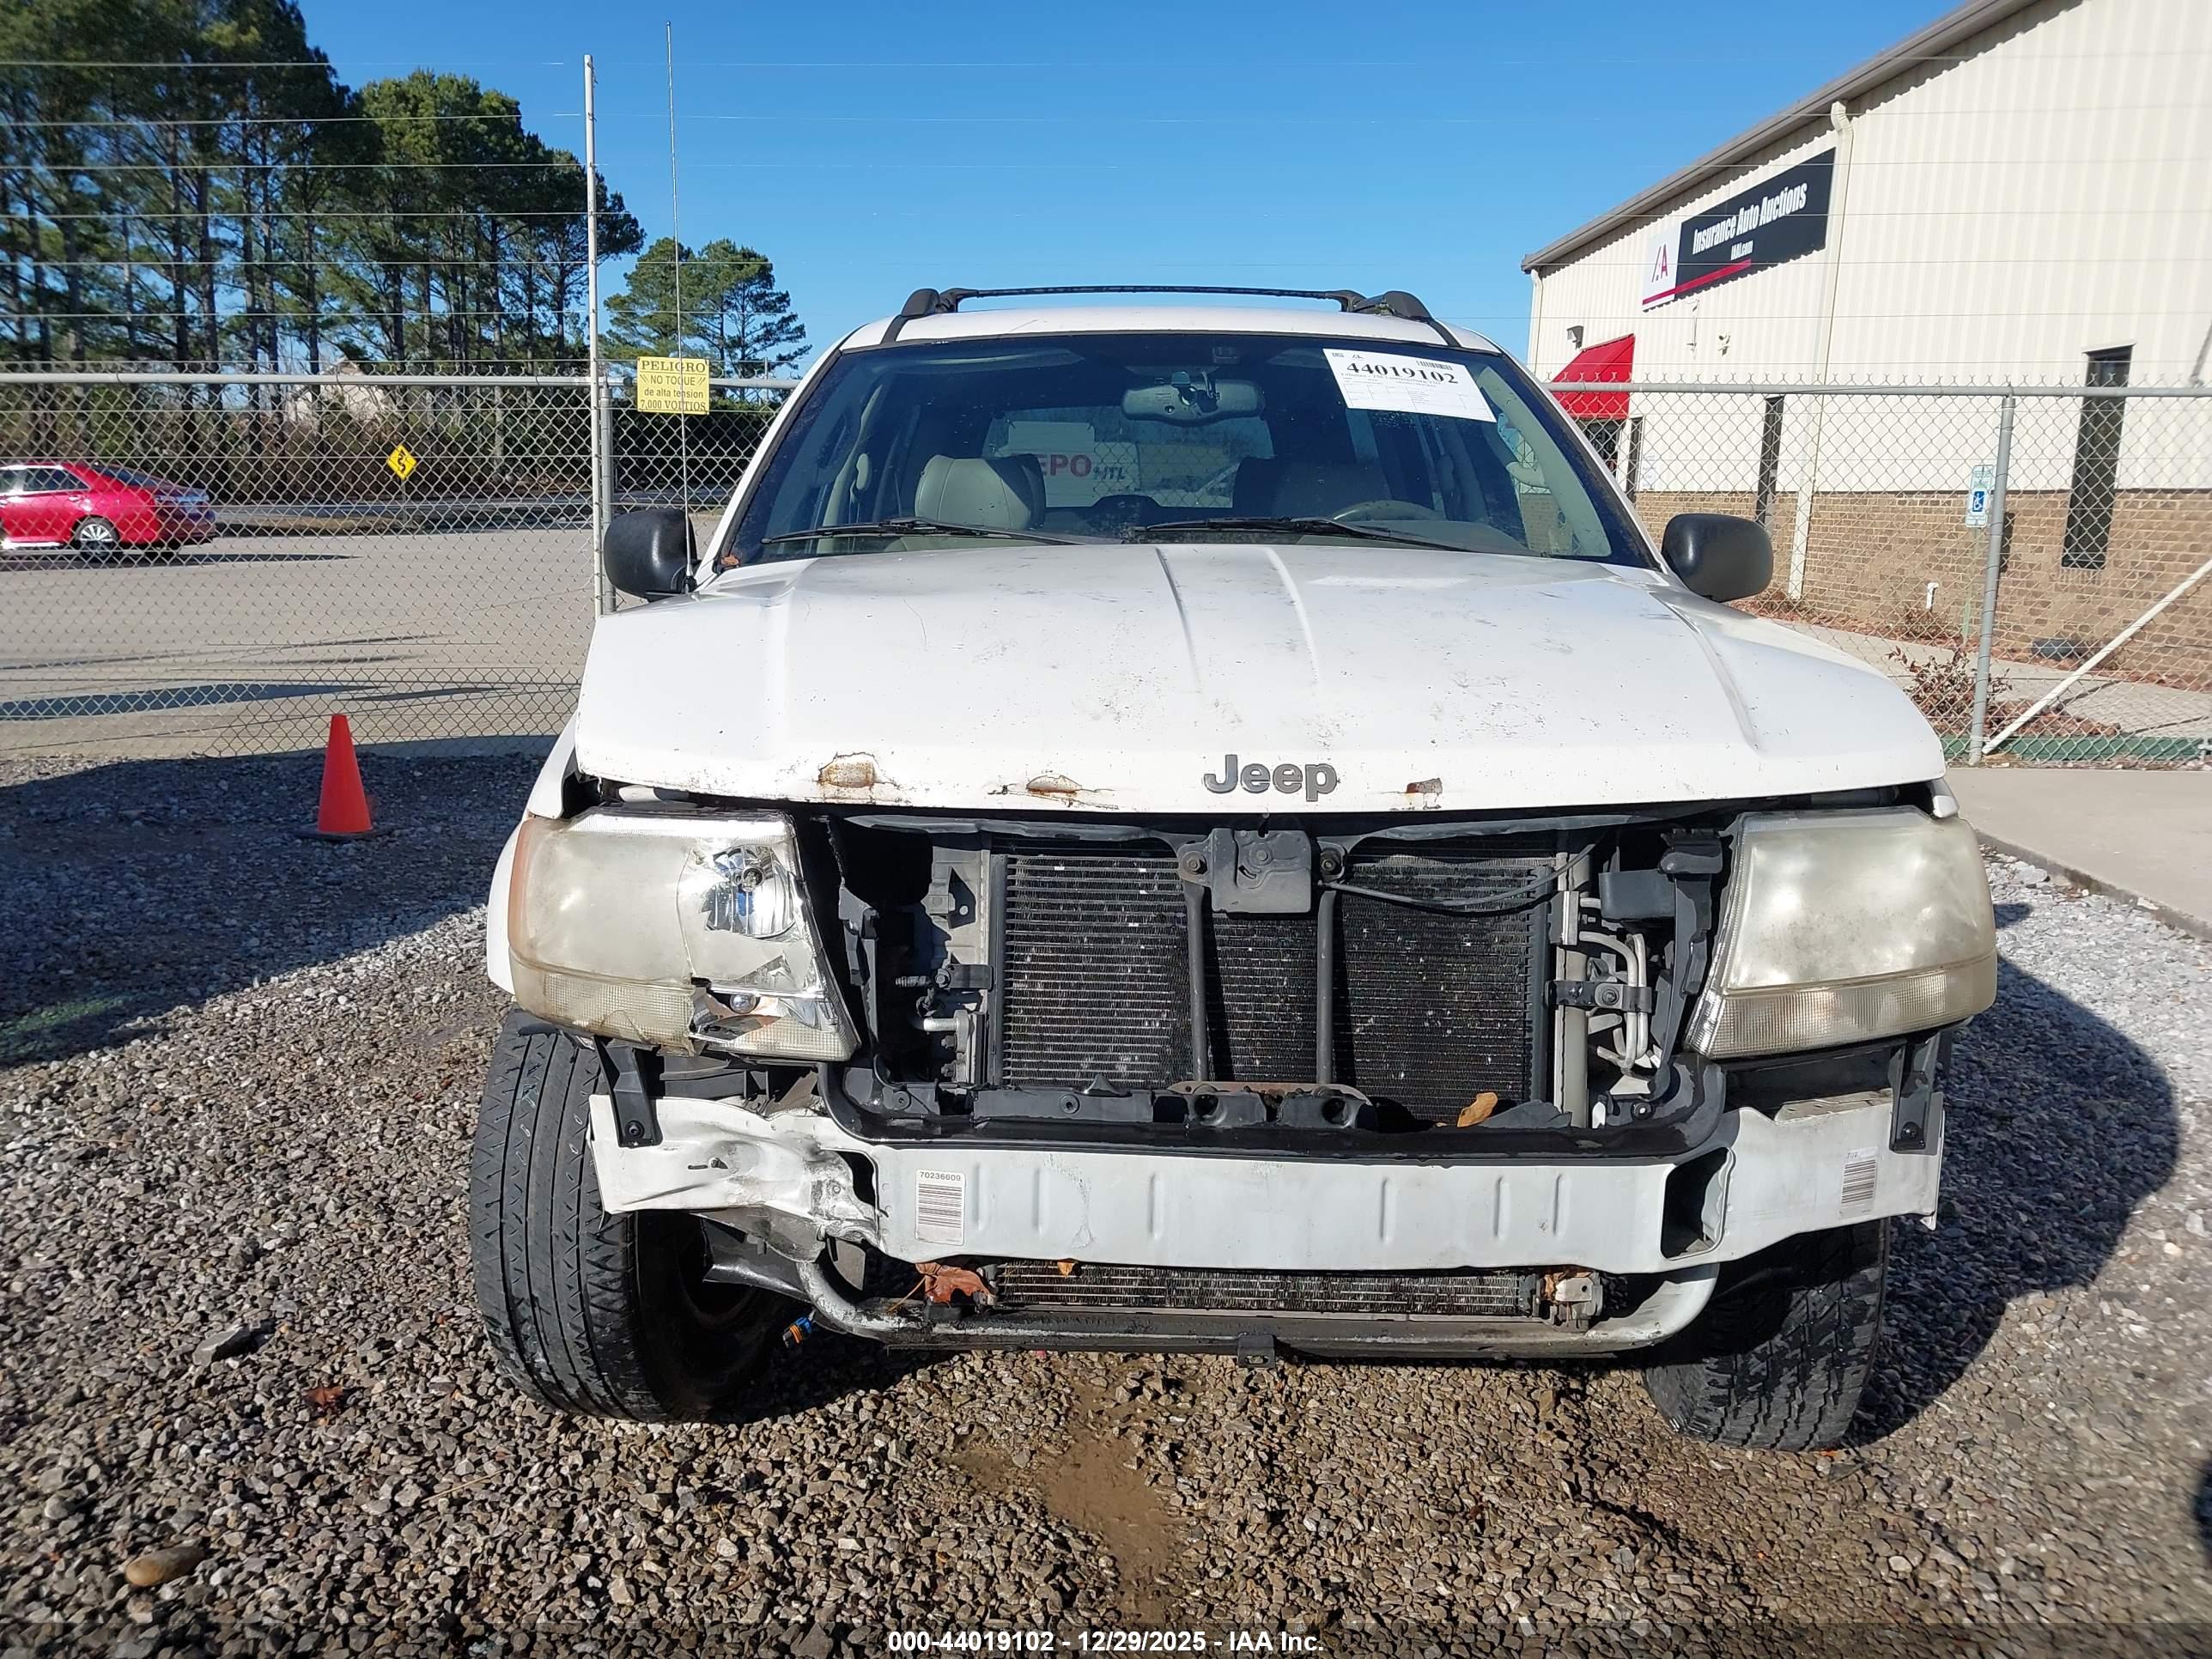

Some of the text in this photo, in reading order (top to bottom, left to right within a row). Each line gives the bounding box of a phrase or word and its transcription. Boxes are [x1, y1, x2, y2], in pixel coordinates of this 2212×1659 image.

[1692, 182, 1808, 255] Insurance Auto Auctions
[641, 360, 706, 373] PELIGRO
[1346, 362, 1459, 384] 44019102
[651, 374, 663, 385] NO
[644, 386, 654, 397] de
[656, 387, 672, 398] alta
[1203, 754, 1338, 802] Jeep
